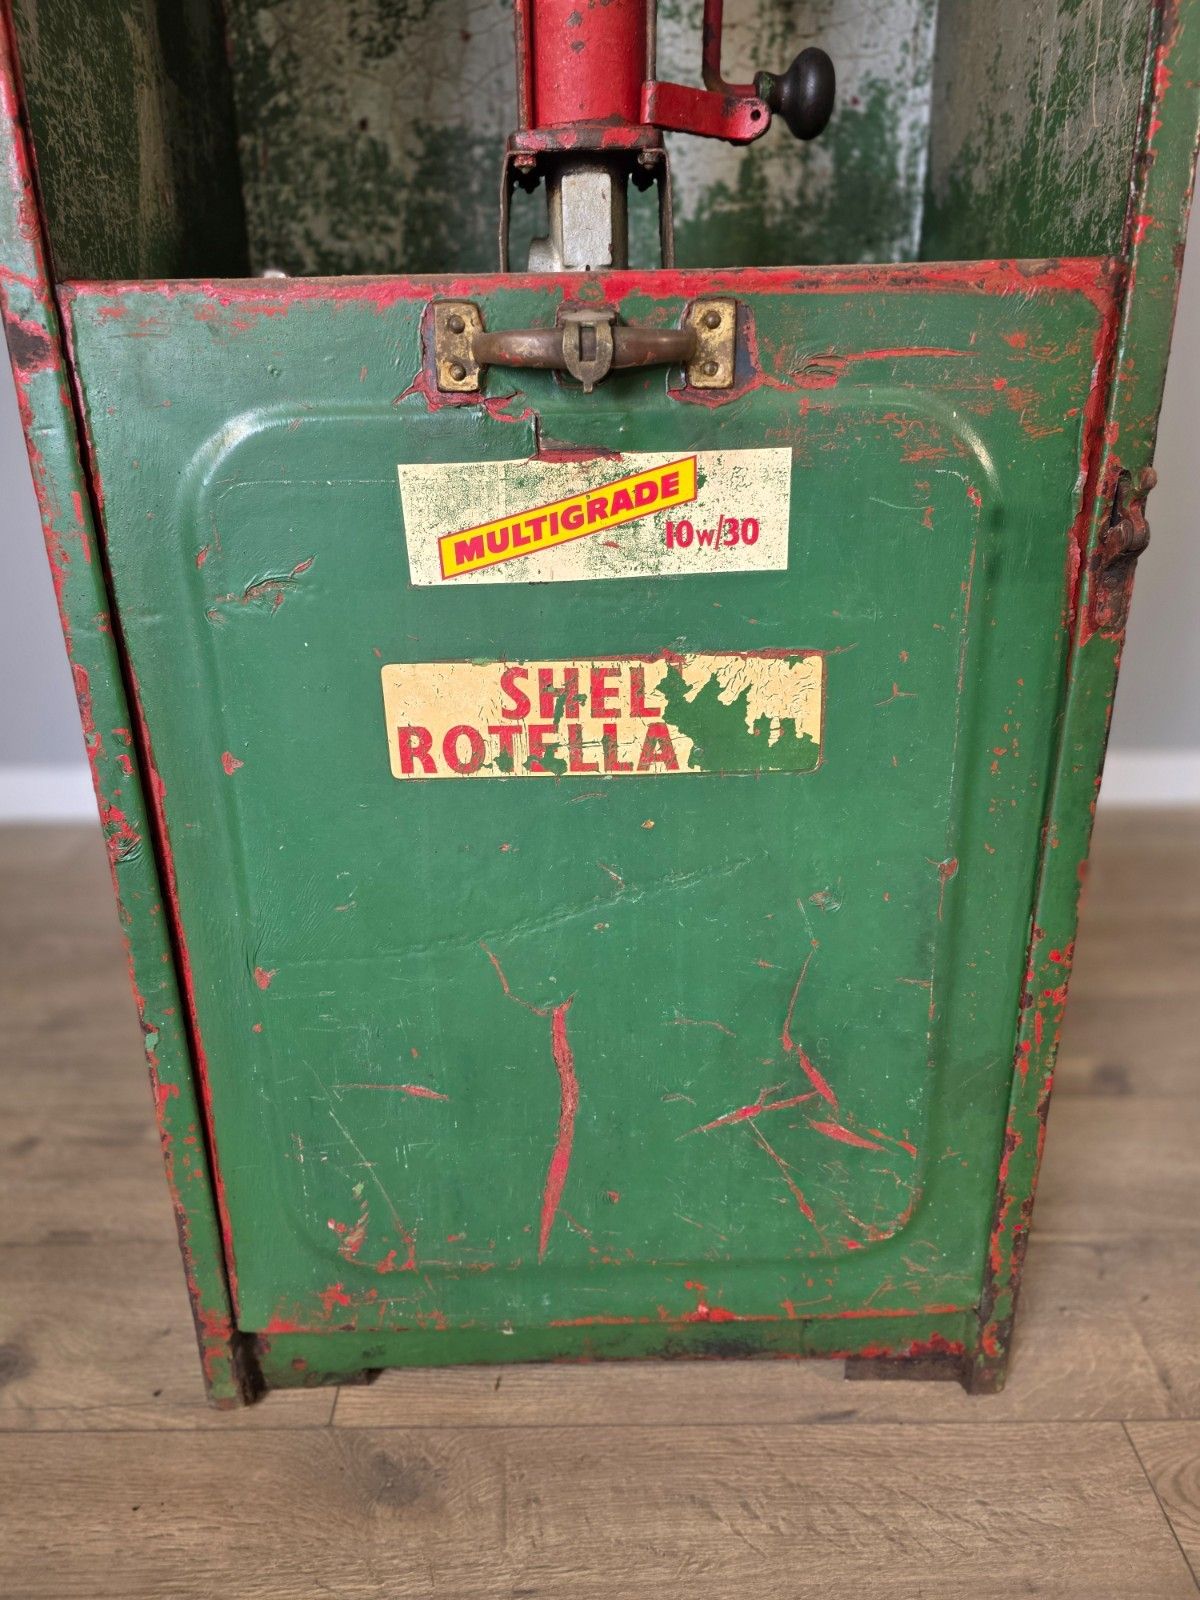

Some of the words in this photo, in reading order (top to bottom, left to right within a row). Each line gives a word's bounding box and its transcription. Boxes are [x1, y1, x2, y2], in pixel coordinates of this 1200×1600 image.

[454, 472, 680, 566] MULTIGRADE
[500, 666, 683, 720] SHEL
[397, 723, 680, 774] ROTELLA
